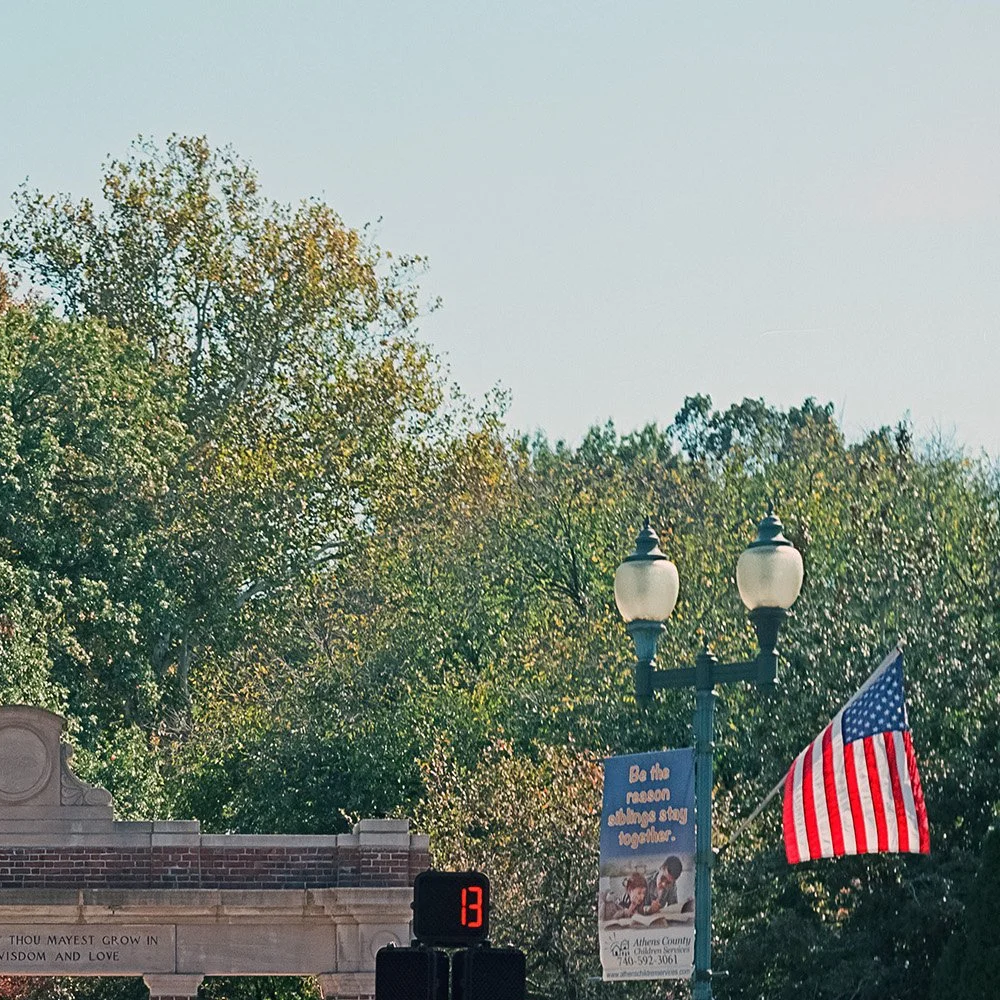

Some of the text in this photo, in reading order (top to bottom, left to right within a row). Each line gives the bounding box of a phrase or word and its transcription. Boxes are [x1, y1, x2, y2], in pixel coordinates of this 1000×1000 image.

[629, 762, 670, 784] Be the
[626, 788, 671, 805] reason
[607, 806, 688, 828] siblings stay
[618, 826, 676, 849] together.
[461, 886, 483, 928] 13
[9, 934, 41, 945] THOU
[47, 934, 95, 945] MAYEST
[102, 934, 141, 945] GROW
[146, 934, 158, 945] IN
[632, 936, 691, 948] Athens County
[55, 951, 81, 961] AND
[88, 951, 120, 961] LOVE
[634, 946, 662, 955] Children
